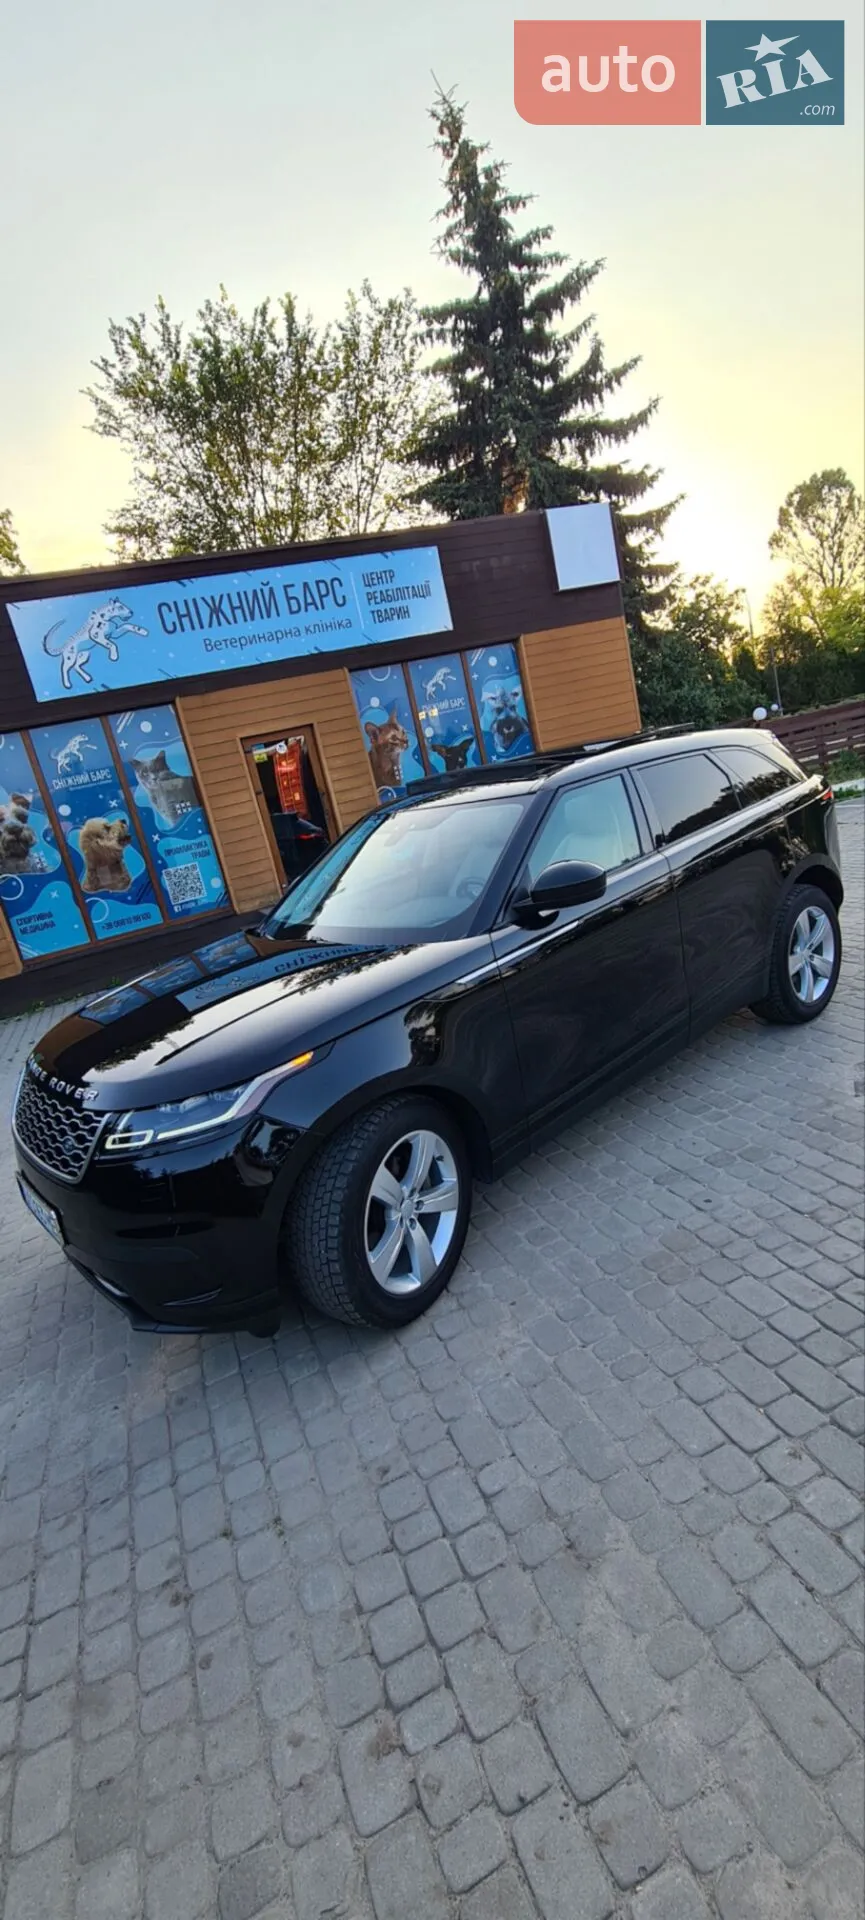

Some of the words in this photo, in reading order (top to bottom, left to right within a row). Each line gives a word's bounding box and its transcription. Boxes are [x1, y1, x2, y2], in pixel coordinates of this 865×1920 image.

[362, 569, 396, 588] ЦЕНТР
[157, 580, 281, 635] СНІЖНИЙ
[283, 576, 347, 616] БАРС
[365, 580, 433, 607] РЕАБІЛІТАЦІЇ
[369, 607, 412, 625] ТВАРИН
[203, 626, 302, 653] Ветеринарна
[303, 617, 353, 638] клініка
[52, 771, 90, 790] СНІЖНИЙ
[90, 768, 113, 783] БАРС
[49, 1077, 99, 1101] ROVER
